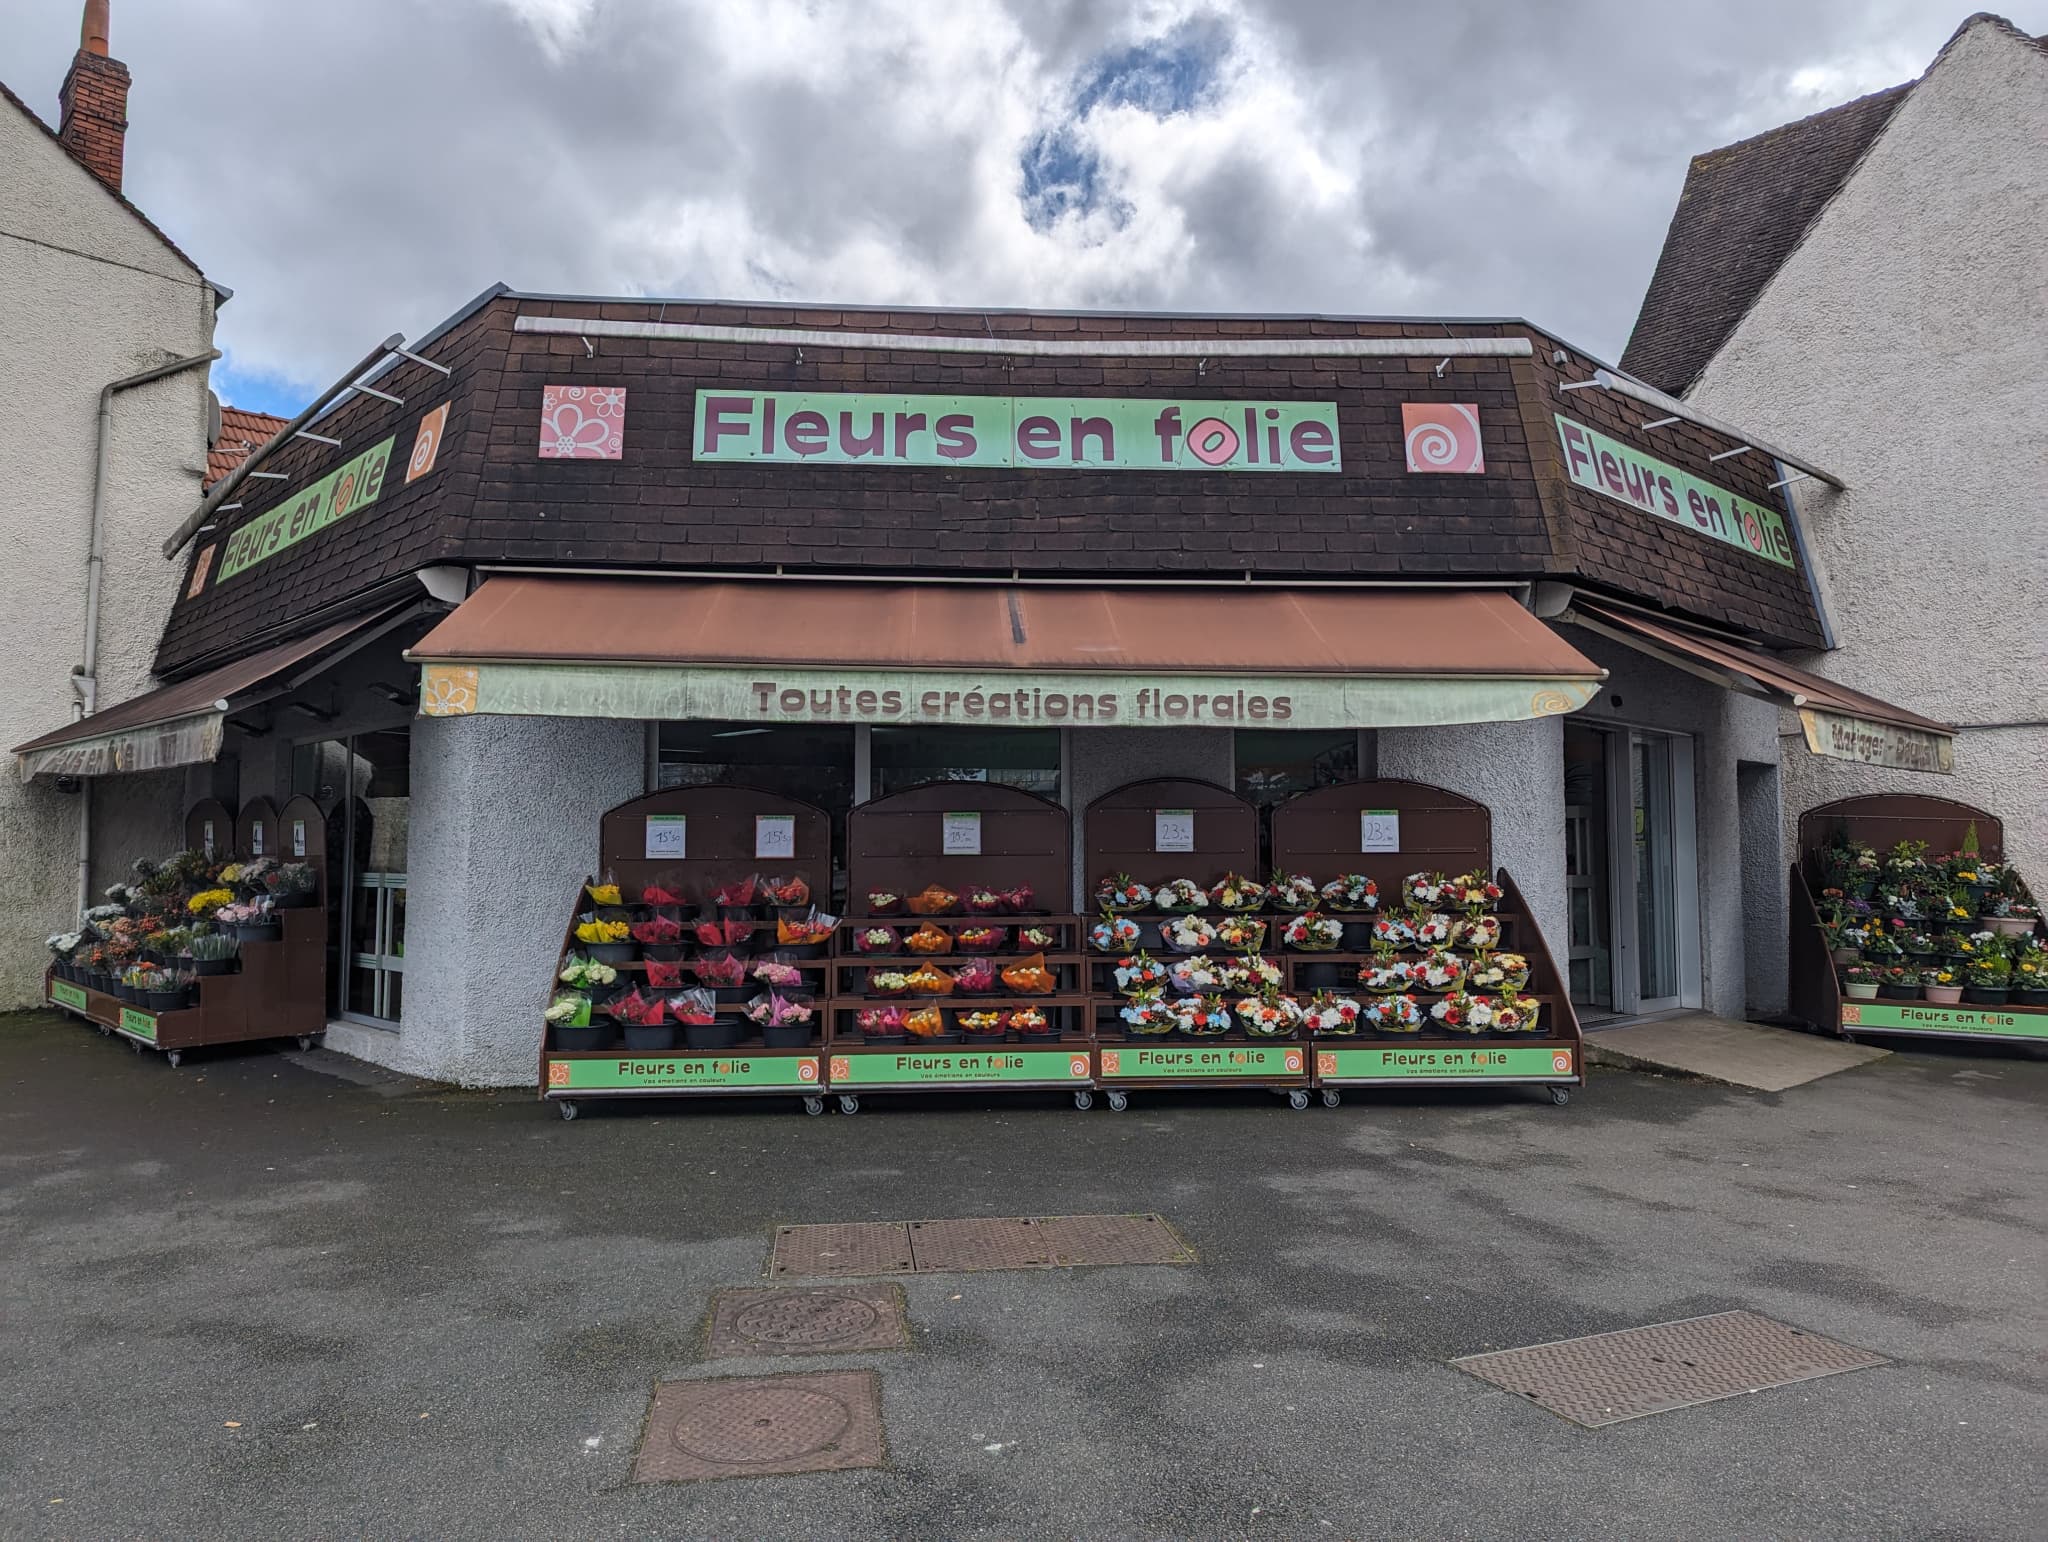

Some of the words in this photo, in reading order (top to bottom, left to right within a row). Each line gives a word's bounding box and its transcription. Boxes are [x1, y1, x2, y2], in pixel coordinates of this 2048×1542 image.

[704, 397, 978, 458] Fleurs
[1017, 412, 1114, 461] en
[1154, 407, 1334, 466] folie
[1560, 421, 1680, 517] Fleurs
[1687, 488, 1727, 536] en
[1731, 498, 1791, 561] folie
[220, 513, 285, 577] Fleurs
[289, 492, 320, 538] en
[325, 453, 385, 521] folie
[752, 682, 902, 714] Toutes
[920, 685, 1118, 719] créations
[1137, 688, 1292, 720] florales
[1901, 1009, 1949, 1022] Fleurs
[1956, 1012, 1974, 1023] en
[1981, 1014, 2014, 1026] folie
[897, 1057, 951, 1070] Fleurs
[959, 1058, 980, 1070] en
[987, 1055, 1024, 1069] folie
[1139, 1052, 1193, 1064] Fleurs
[1201, 1052, 1221, 1064] en
[1229, 1050, 1265, 1064] folie
[1382, 1052, 1436, 1065] Fleurs
[1443, 1053, 1463, 1064] en
[1471, 1052, 1507, 1065] folie
[618, 1061, 676, 1075] Fleurs
[683, 1062, 705, 1074] en
[712, 1060, 750, 1074] folie
